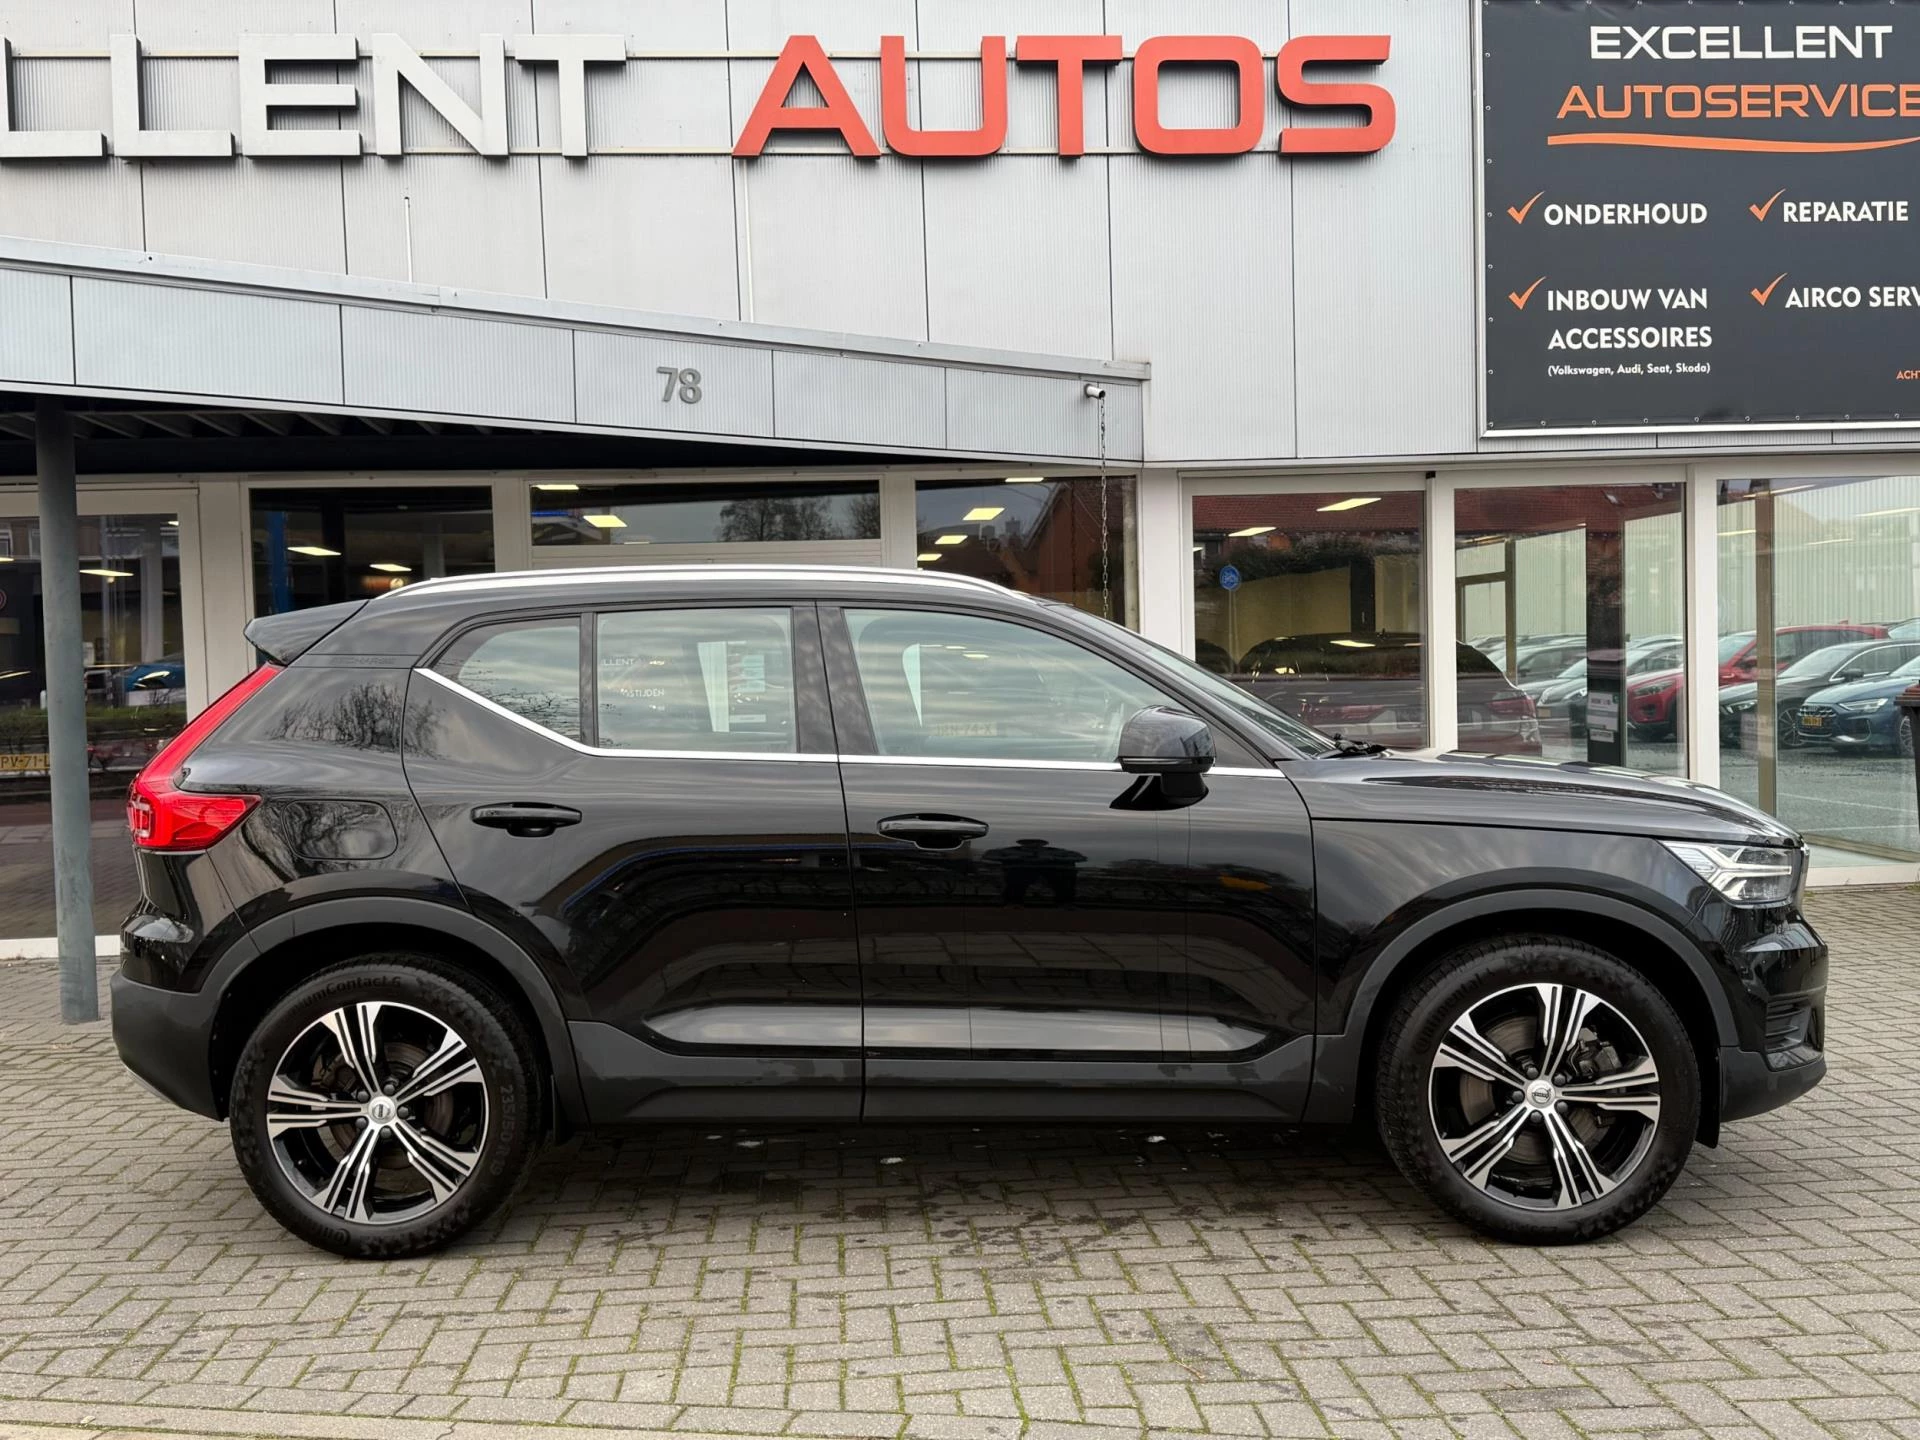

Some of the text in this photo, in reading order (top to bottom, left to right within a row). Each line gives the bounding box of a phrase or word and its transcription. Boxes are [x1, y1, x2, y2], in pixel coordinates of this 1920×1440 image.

[1590, 25, 1893, 60] EXCELLENT
[0, 34, 1397, 157] LLENT AUTOS
[1557, 83, 1920, 119] AUTOSERVICE
[1543, 202, 1708, 226] ONDERHOUD
[1783, 201, 1909, 223] REPARATIE
[1547, 287, 1708, 311] INBOUW VAN
[1784, 286, 1862, 308] AIRCO
[1547, 326, 1713, 350] ACCESSOIRES
[1547, 362, 1711, 377] (Volkswagen, Audi, Seat, Skoda)
[1896, 370, 1920, 380] ACH
[656, 366, 702, 404] 78
[0, 755, 50, 769] PV-71-L
